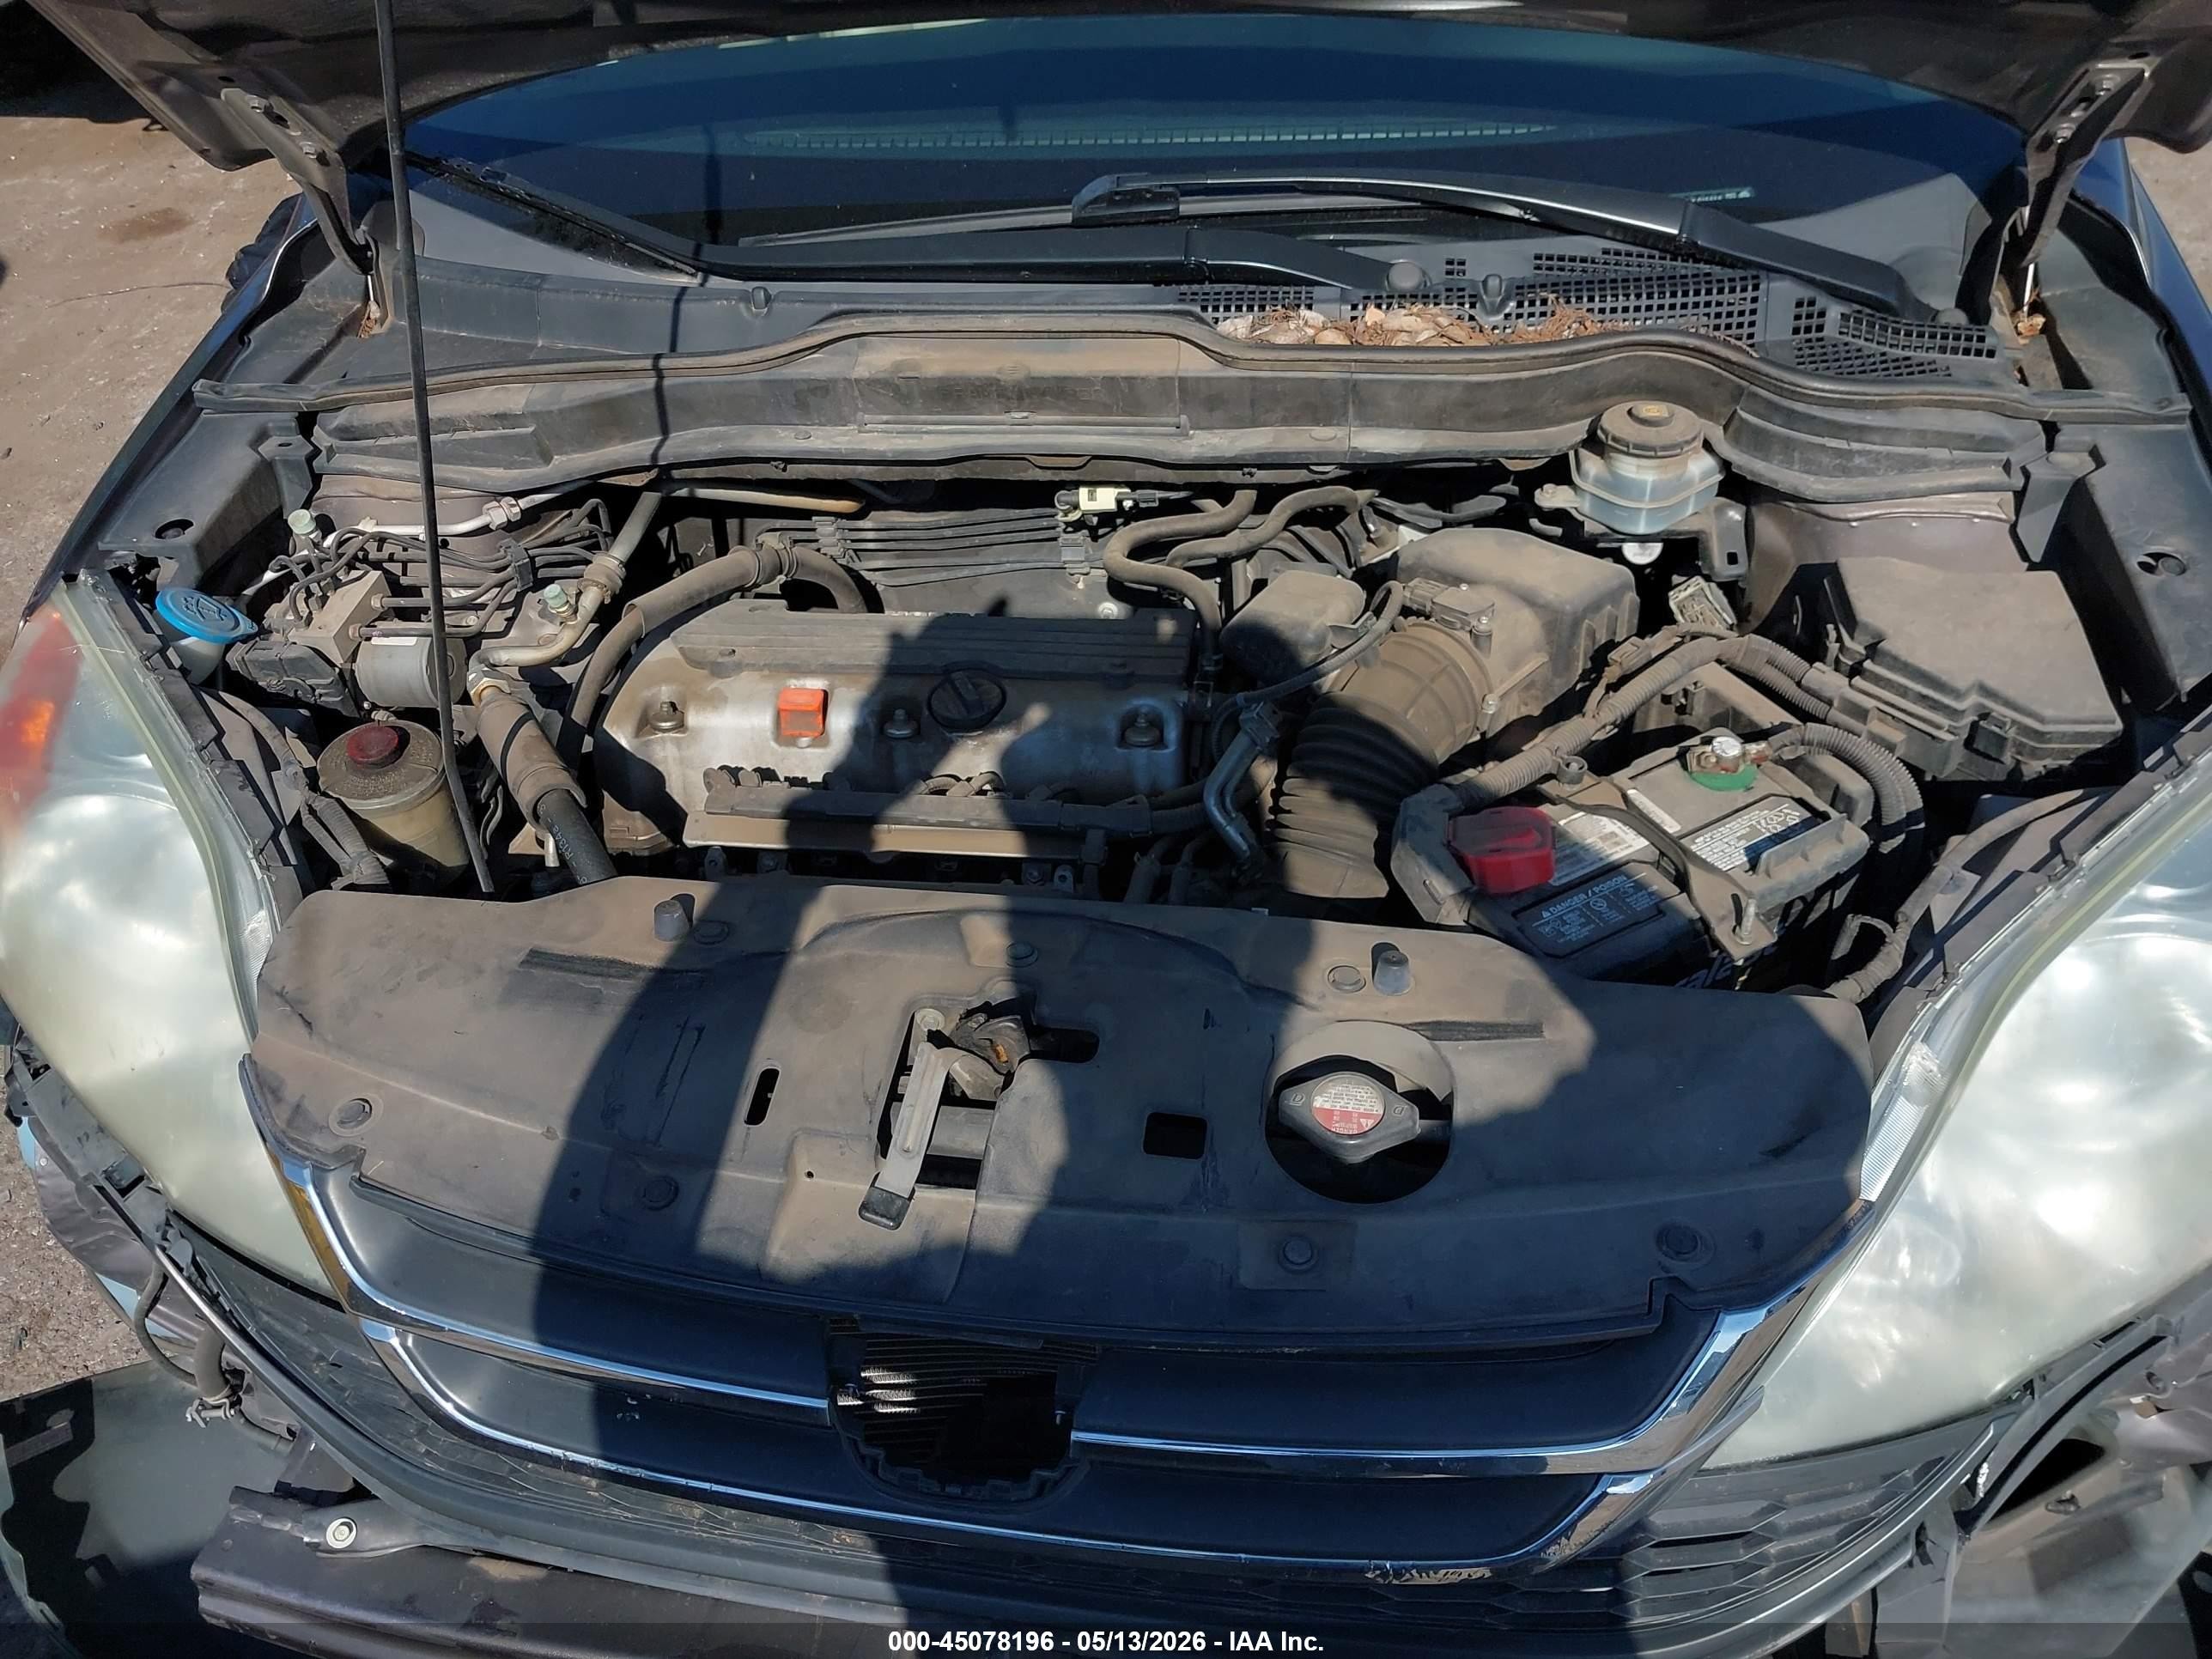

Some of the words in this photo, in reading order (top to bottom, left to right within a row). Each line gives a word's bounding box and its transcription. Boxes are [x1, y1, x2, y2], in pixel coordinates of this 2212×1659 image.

[552, 824, 574, 860] R134a
[1548, 893, 1588, 915] DANGER
[1592, 874, 1628, 894] POISON
